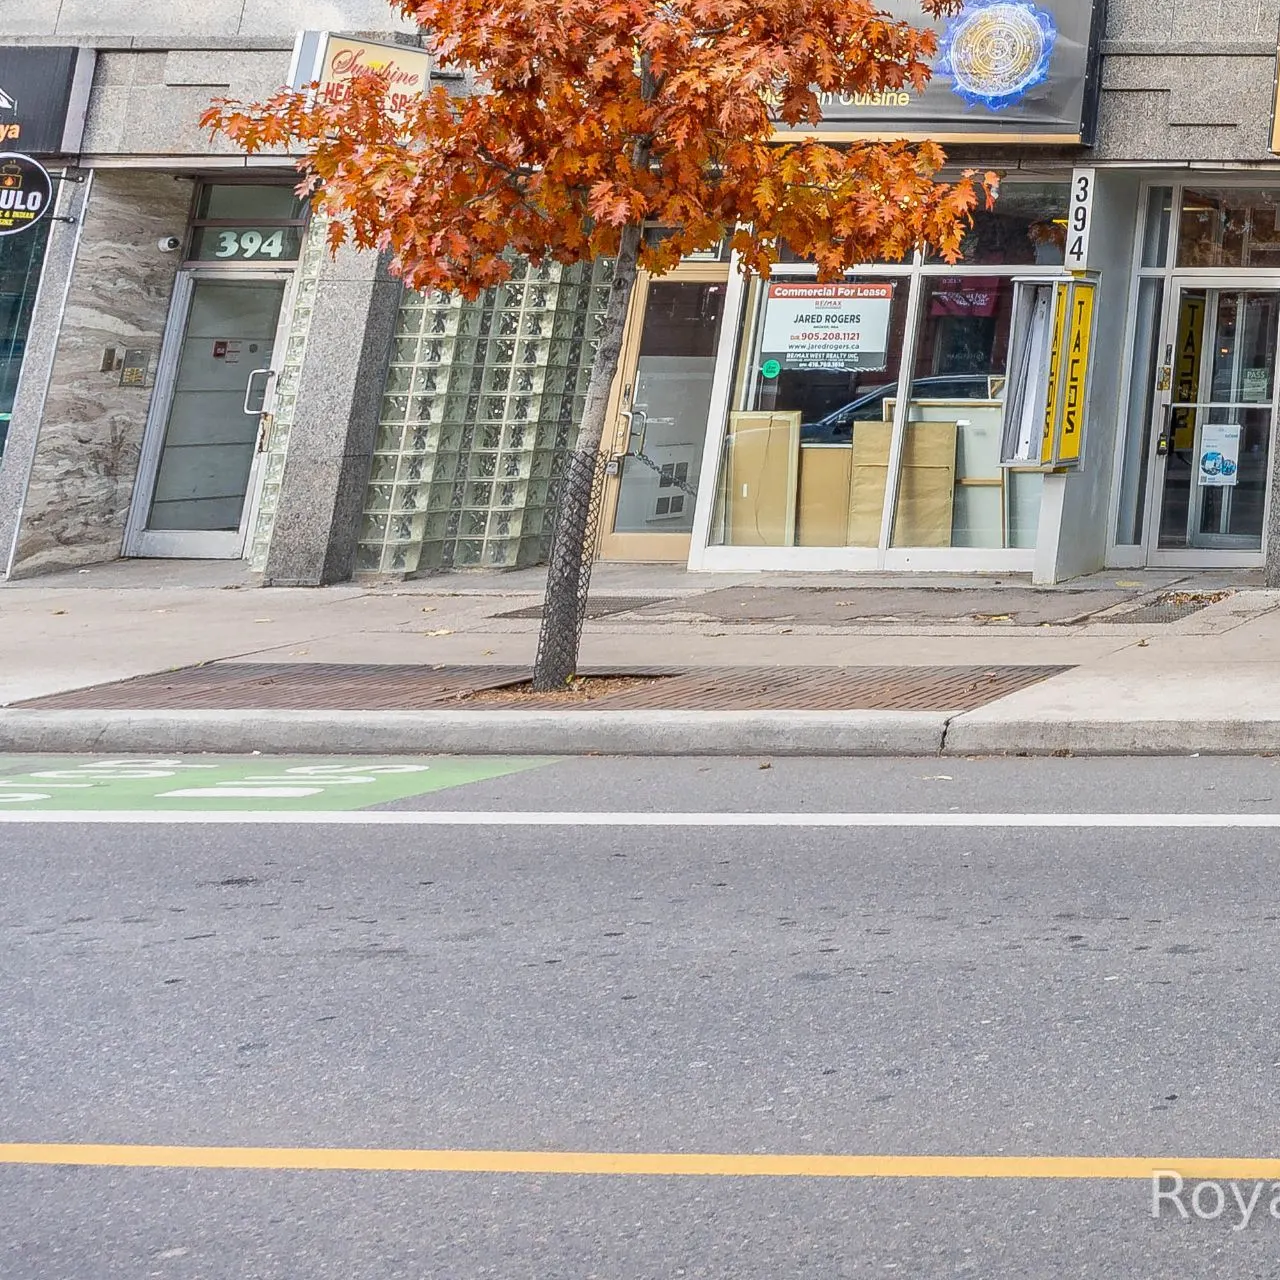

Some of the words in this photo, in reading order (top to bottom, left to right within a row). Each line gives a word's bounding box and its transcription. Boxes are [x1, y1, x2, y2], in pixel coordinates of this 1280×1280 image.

[0, 189, 42, 211] ULO
[1069, 176, 1088, 262] 394
[216, 230, 284, 258] 394
[774, 287, 835, 296] Commercial
[838, 288, 855, 296] For
[857, 288, 887, 296] Lease
[794, 314, 823, 324] JARED
[824, 314, 861, 324] ROGERS
[801, 332, 860, 340] 905.208.1121
[788, 343, 860, 351] www.jaredrogers.ca
